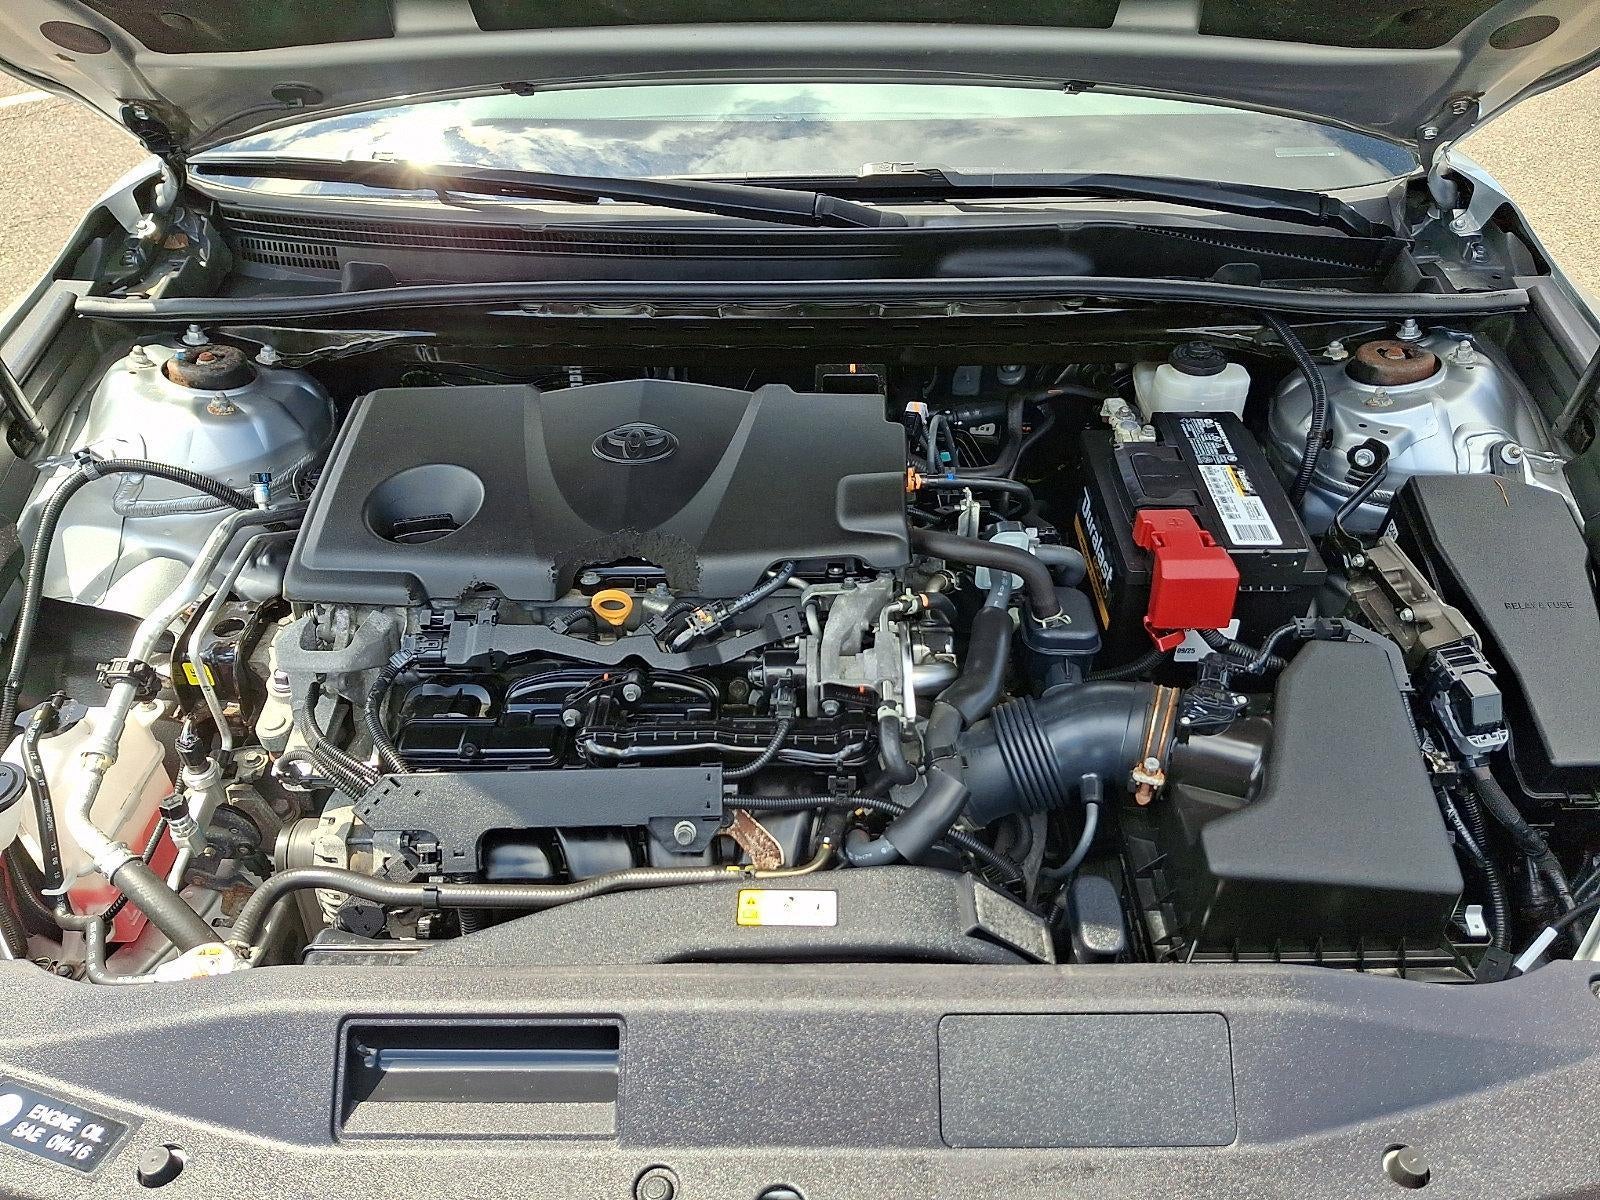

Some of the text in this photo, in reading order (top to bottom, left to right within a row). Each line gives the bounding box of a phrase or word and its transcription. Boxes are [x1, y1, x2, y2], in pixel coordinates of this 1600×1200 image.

[1082, 486, 1113, 591] Duralast
[1503, 602, 1536, 610] RELAY
[27, 1103, 82, 1133] ENGINE
[11, 1121, 94, 1160] SAE 0W-16
